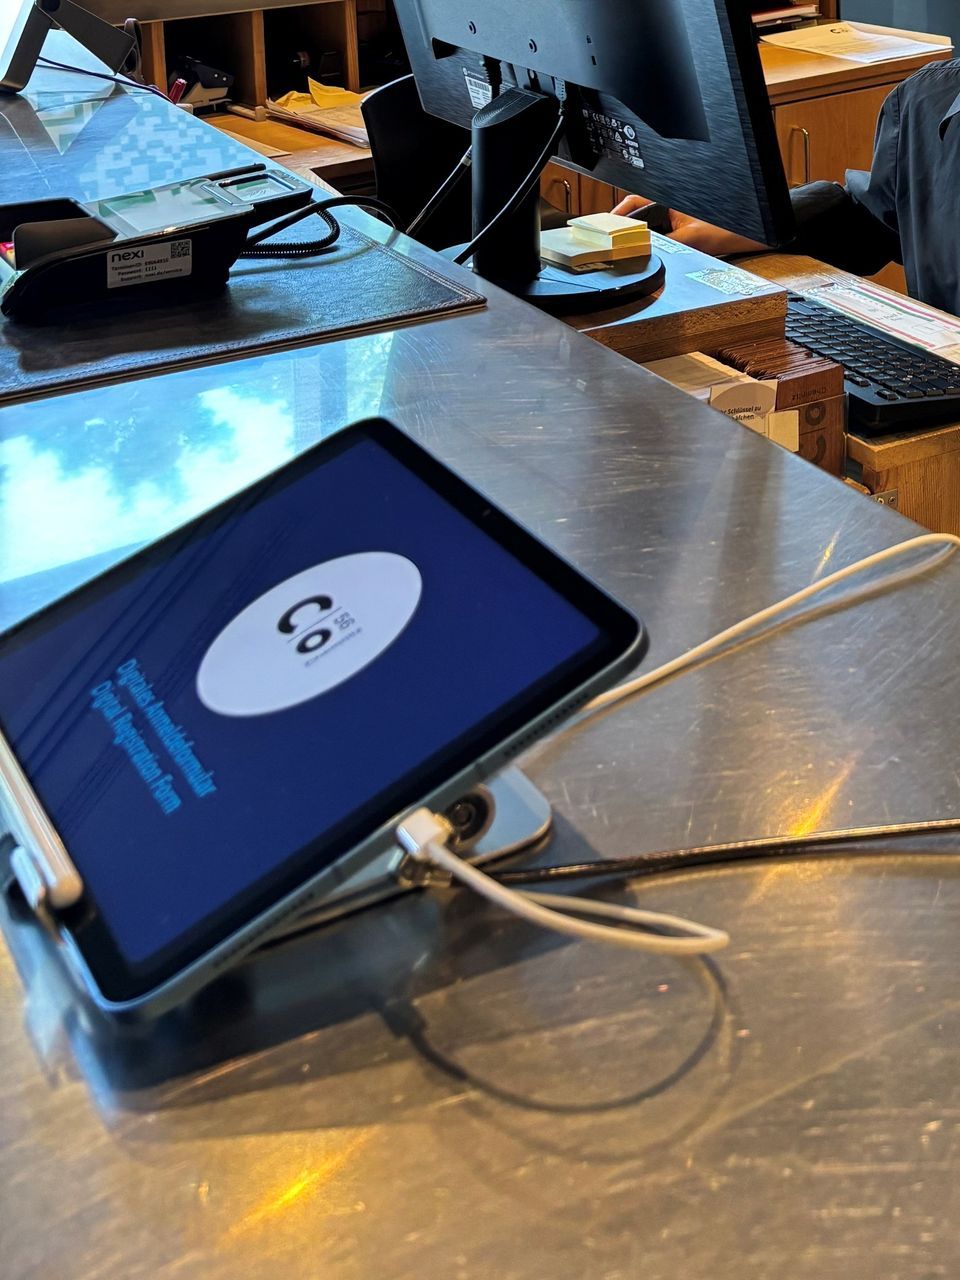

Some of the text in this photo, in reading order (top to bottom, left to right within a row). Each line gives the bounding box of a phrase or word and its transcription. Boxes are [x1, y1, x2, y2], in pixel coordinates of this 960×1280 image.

[111, 250, 144, 263] nexi
[727, 405, 754, 415] Schlüssel
[91, 680, 182, 815] Digital Registration Form
[117, 658, 217, 798] Digitales Anmeldeformular
